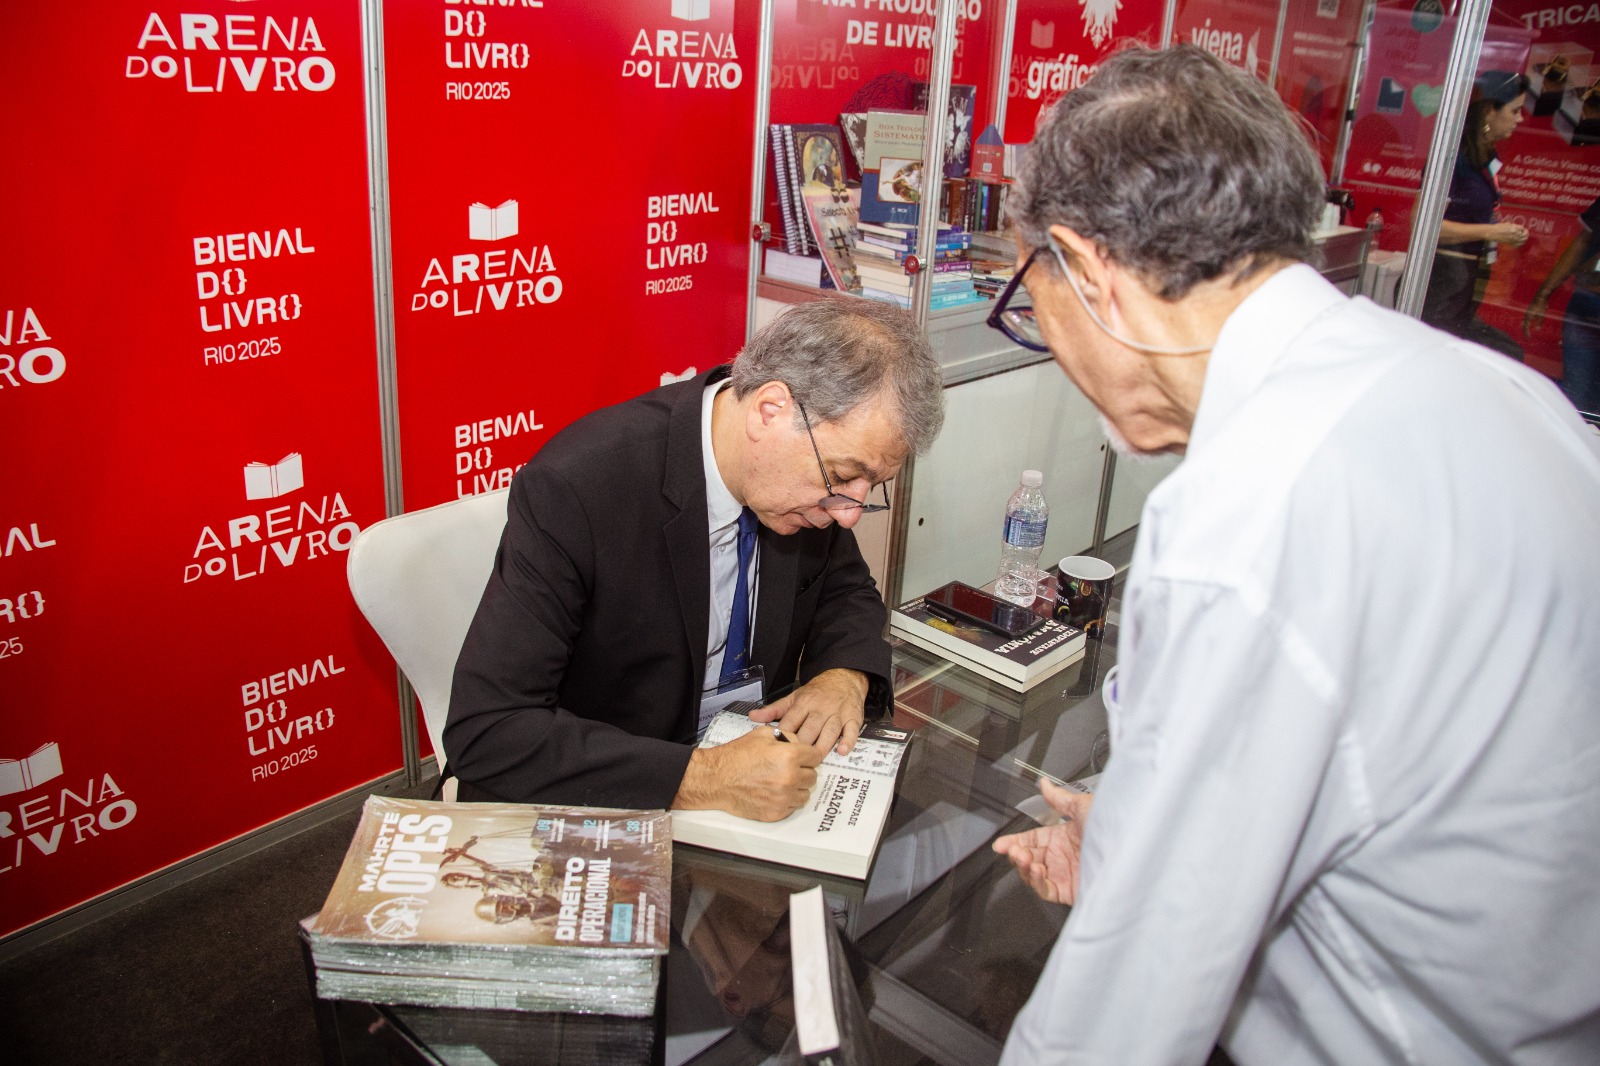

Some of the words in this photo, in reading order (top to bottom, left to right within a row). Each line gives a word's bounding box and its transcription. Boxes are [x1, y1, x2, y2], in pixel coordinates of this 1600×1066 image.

[137, 12, 326, 51] ARENA
[631, 28, 739, 60] ARENA
[846, 20, 878, 46] DE
[125, 55, 178, 78] DO
[184, 56, 336, 92] LIVRO
[446, 82, 472, 100] RIO
[474, 82, 511, 100] 2025
[622, 59, 652, 78] DO
[655, 62, 743, 90] LIVRO
[648, 192, 719, 218] BIENAL
[193, 228, 315, 267] BIENAL
[421, 245, 556, 289] ARENA
[411, 289, 449, 312] DO
[453, 275, 563, 317] LIVRO
[645, 279, 665, 296] RIO
[666, 275, 693, 293] 2025
[203, 344, 236, 366] RIO
[237, 337, 282, 361] 2025
[455, 410, 544, 449] BIENAL
[193, 492, 352, 558] ARENA
[183, 557, 226, 583] DO
[232, 522, 361, 582] LIVRO
[241, 654, 346, 706] BIENAL
[252, 760, 279, 782] RIO
[280, 745, 318, 772] 2025
[848, 779, 871, 826] TEMPESTADE
[849, 778, 860, 790] NA
[817, 775, 850, 833] AMAZÔNIA
[358, 811, 401, 893] MAHRTE
[377, 813, 453, 894] OPES
[555, 857, 586, 942] DIREITO
[579, 856, 612, 942] OPERACIONAL
